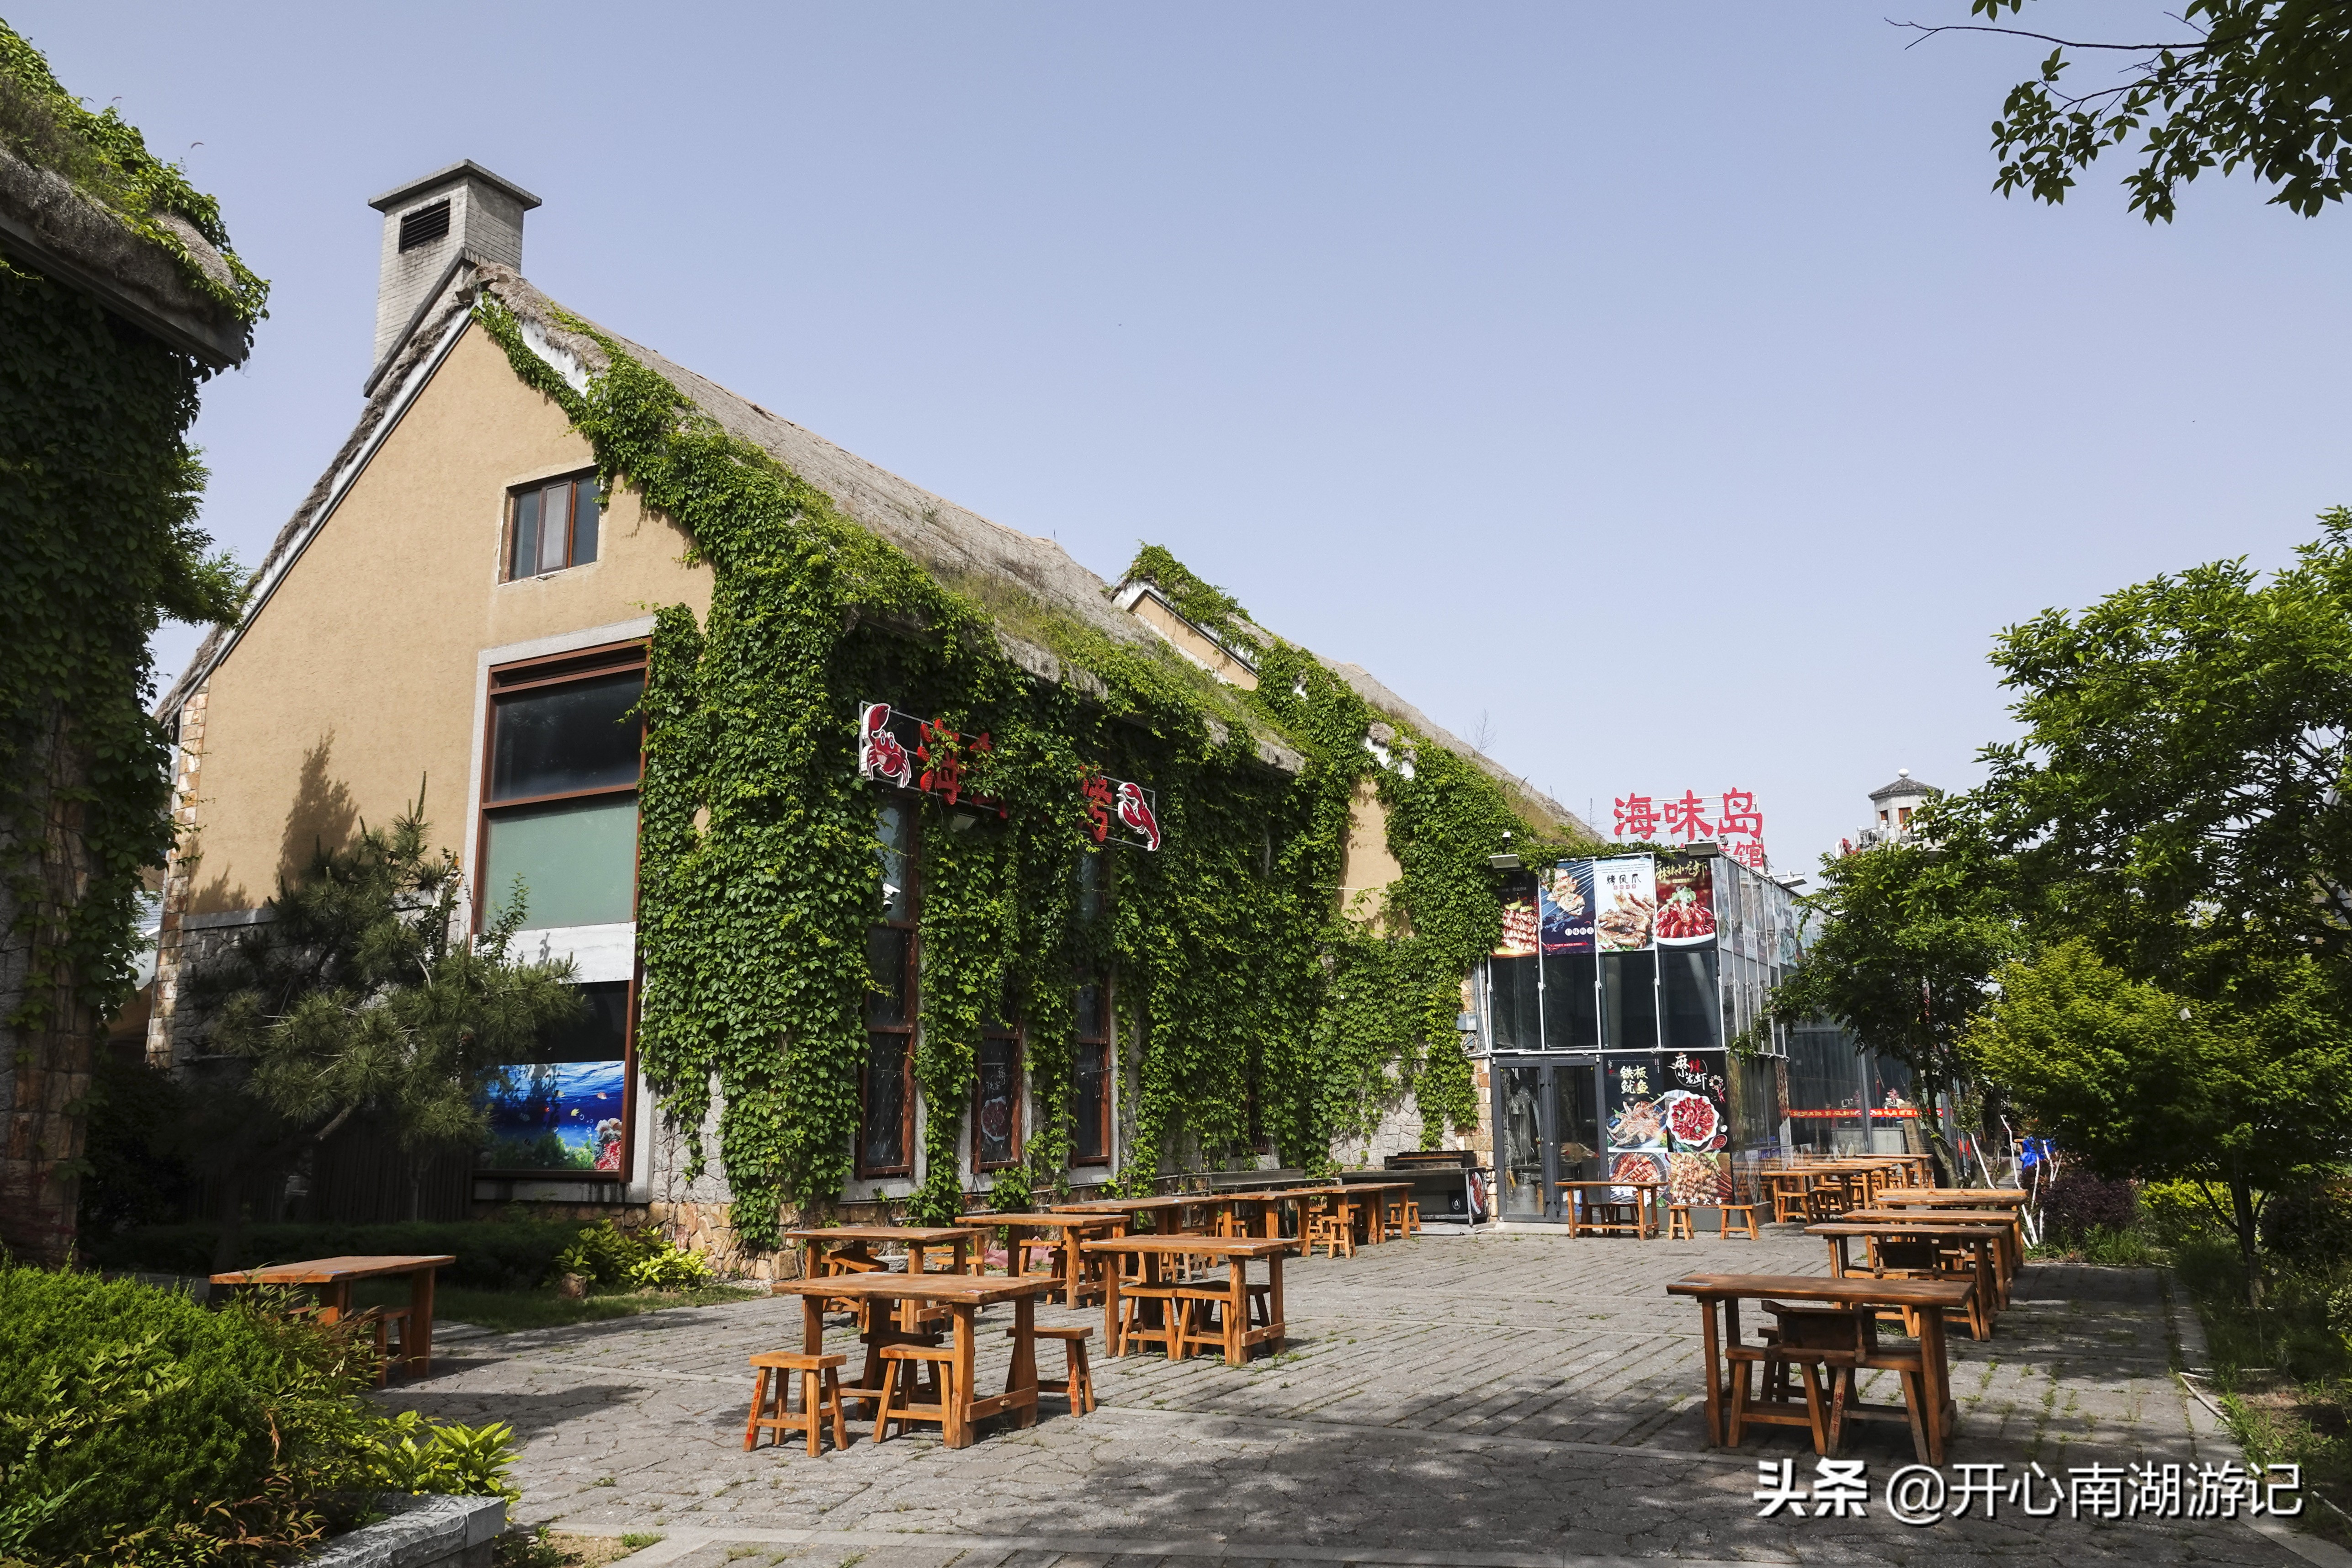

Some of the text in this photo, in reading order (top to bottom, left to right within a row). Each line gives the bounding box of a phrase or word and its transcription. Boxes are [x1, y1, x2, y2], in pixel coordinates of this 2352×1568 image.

[1614, 787, 1763, 840] 海味岛
[1607, 873, 1641, 886] 烤凤爪
[1655, 860, 1708, 881] 麻辣小龙虾
[1620, 1065, 1648, 1079] 铁板
[1678, 1069, 1708, 1091] 小龙虾
[1621, 1079, 1650, 1095] 鱿鱼
